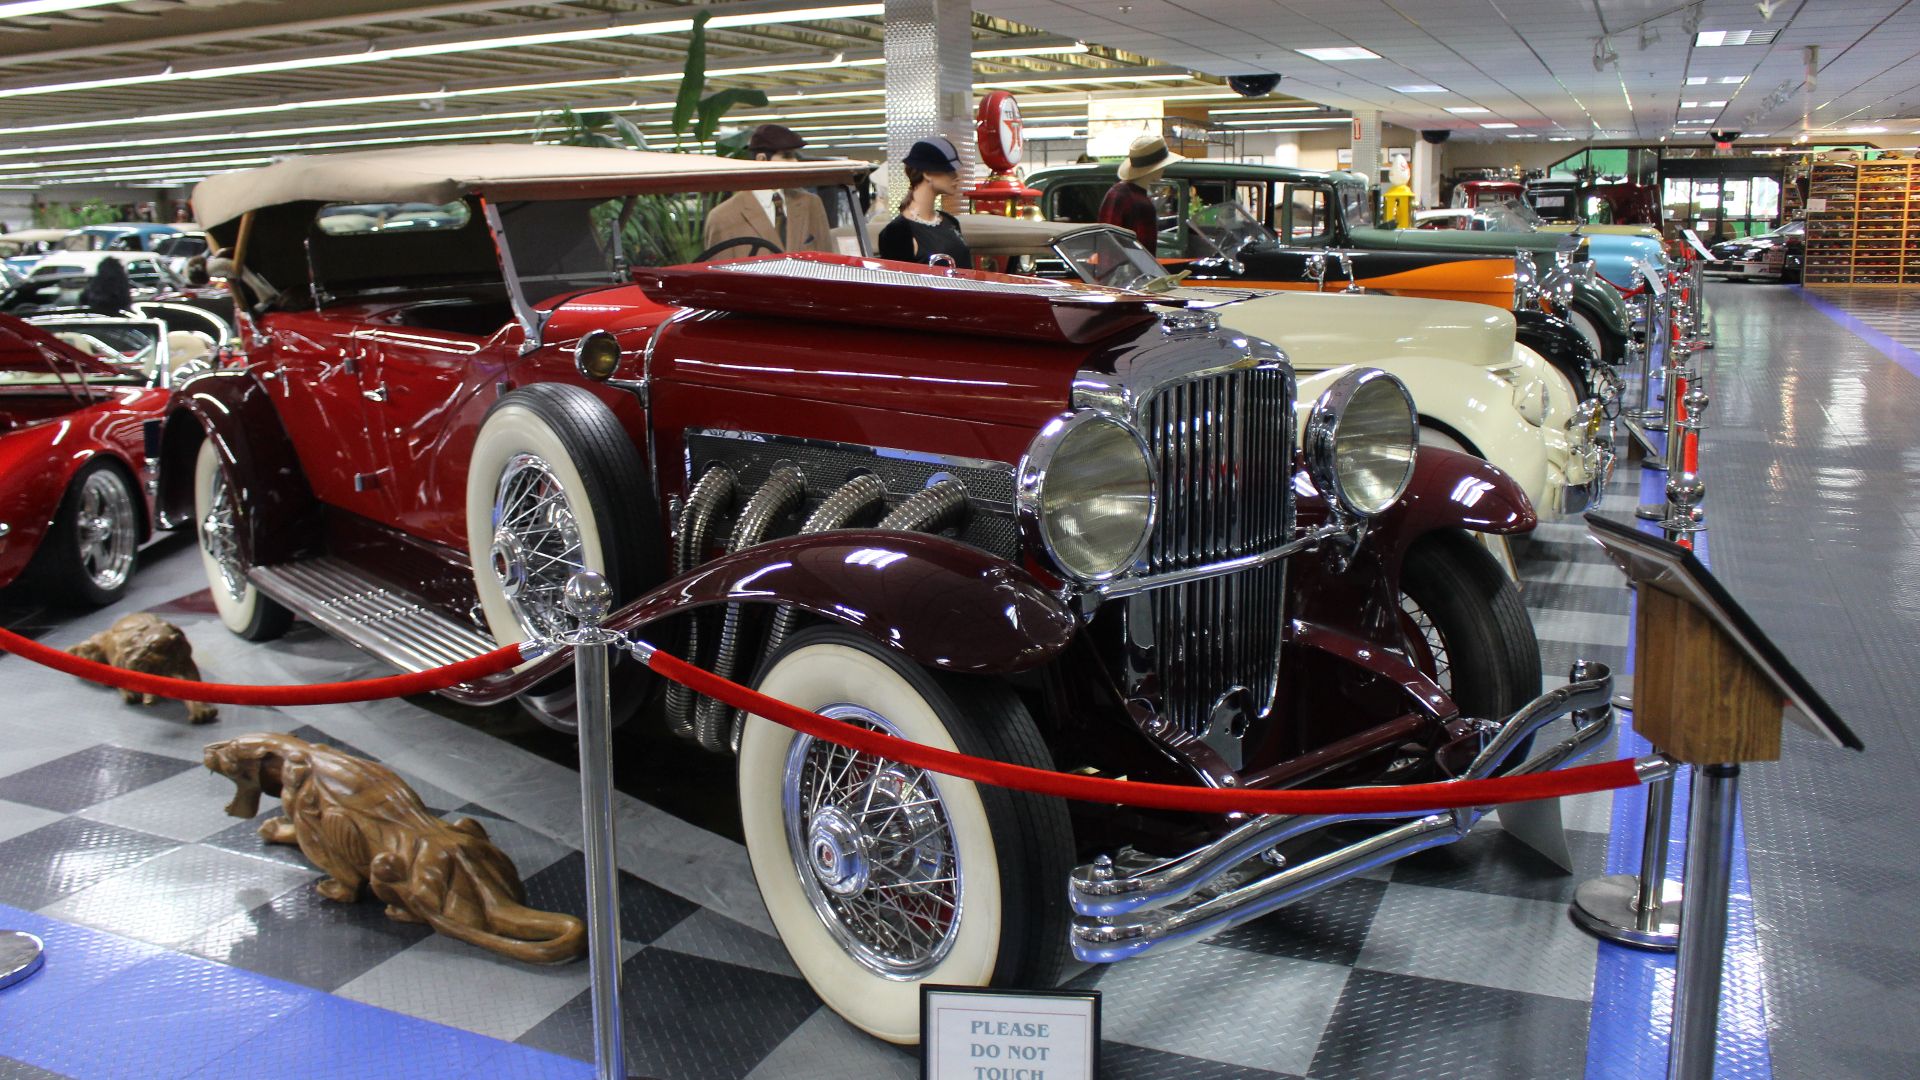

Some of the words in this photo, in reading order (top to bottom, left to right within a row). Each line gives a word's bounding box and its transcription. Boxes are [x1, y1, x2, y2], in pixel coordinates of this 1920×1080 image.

[971, 1020, 1049, 1038] PLEASE
[971, 1043, 1000, 1058] DO
[1008, 1045, 1049, 1061] NOT
[974, 1066, 1044, 1080] TOUCH
